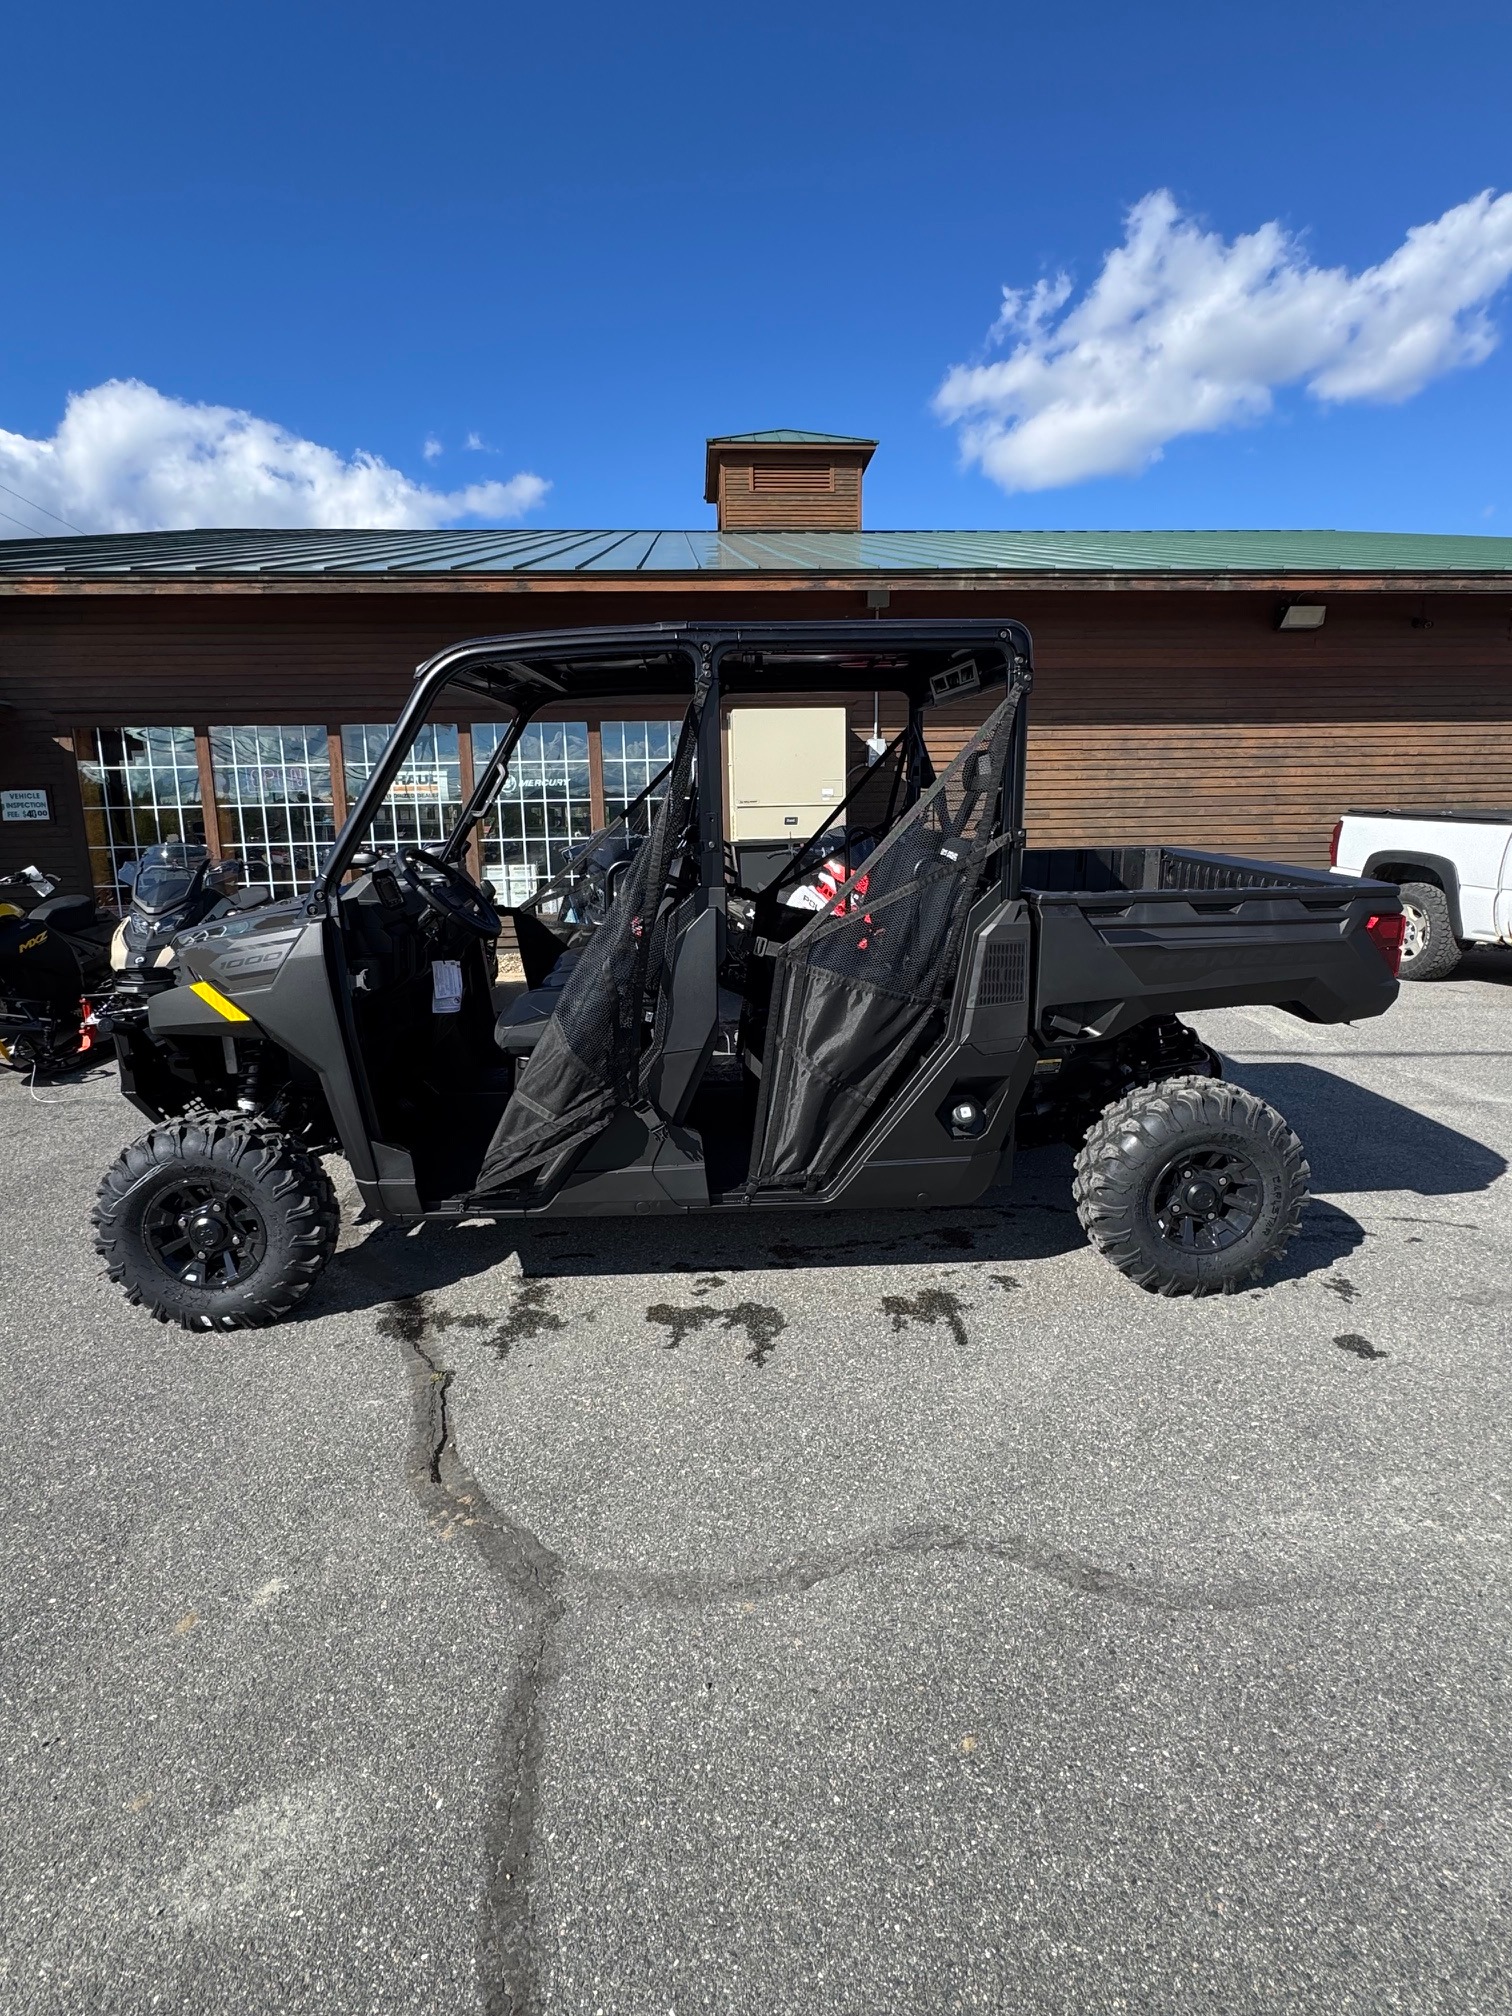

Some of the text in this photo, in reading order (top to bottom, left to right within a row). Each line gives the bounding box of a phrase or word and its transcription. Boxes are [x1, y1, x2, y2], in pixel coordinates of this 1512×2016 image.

[518, 778, 571, 787] MERCURY
[19, 930, 48, 953] MXZ
[220, 951, 283, 970] 1000
